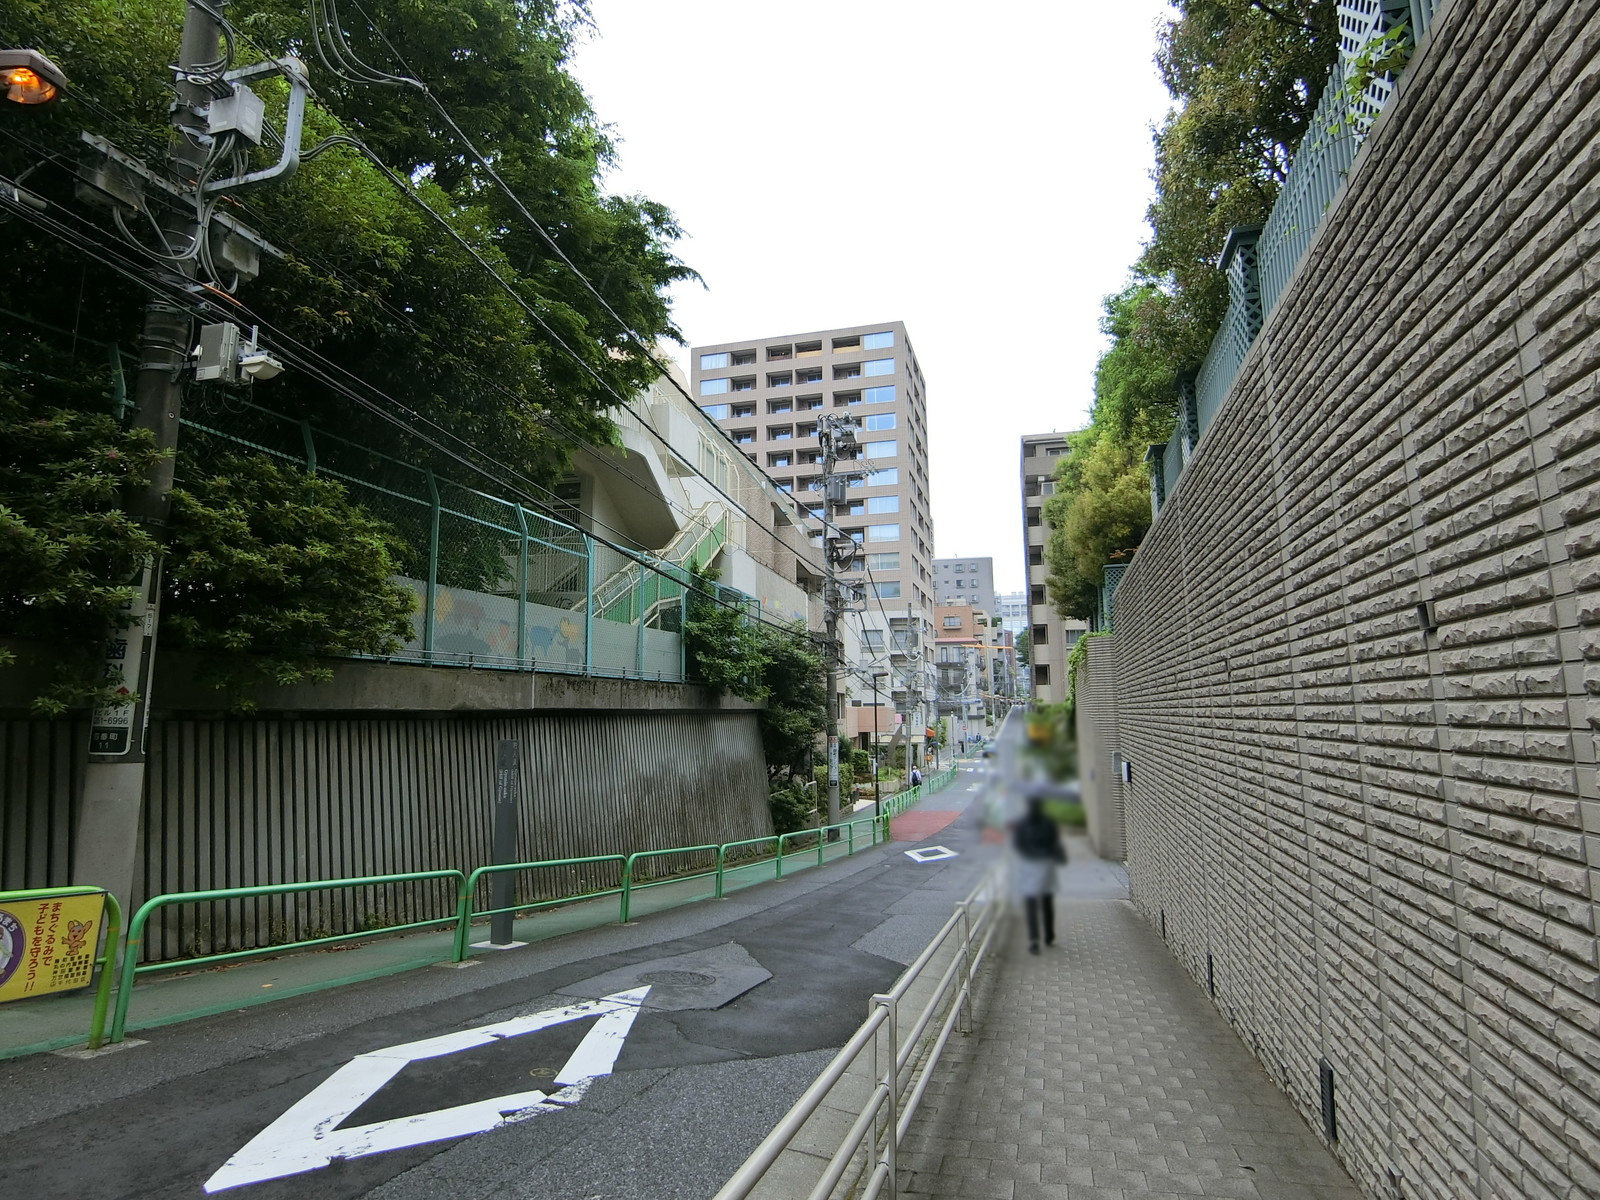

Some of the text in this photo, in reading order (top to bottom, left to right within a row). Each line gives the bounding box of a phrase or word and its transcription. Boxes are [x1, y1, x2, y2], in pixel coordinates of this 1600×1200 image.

[42, 902, 62, 967] まちぐるみで
